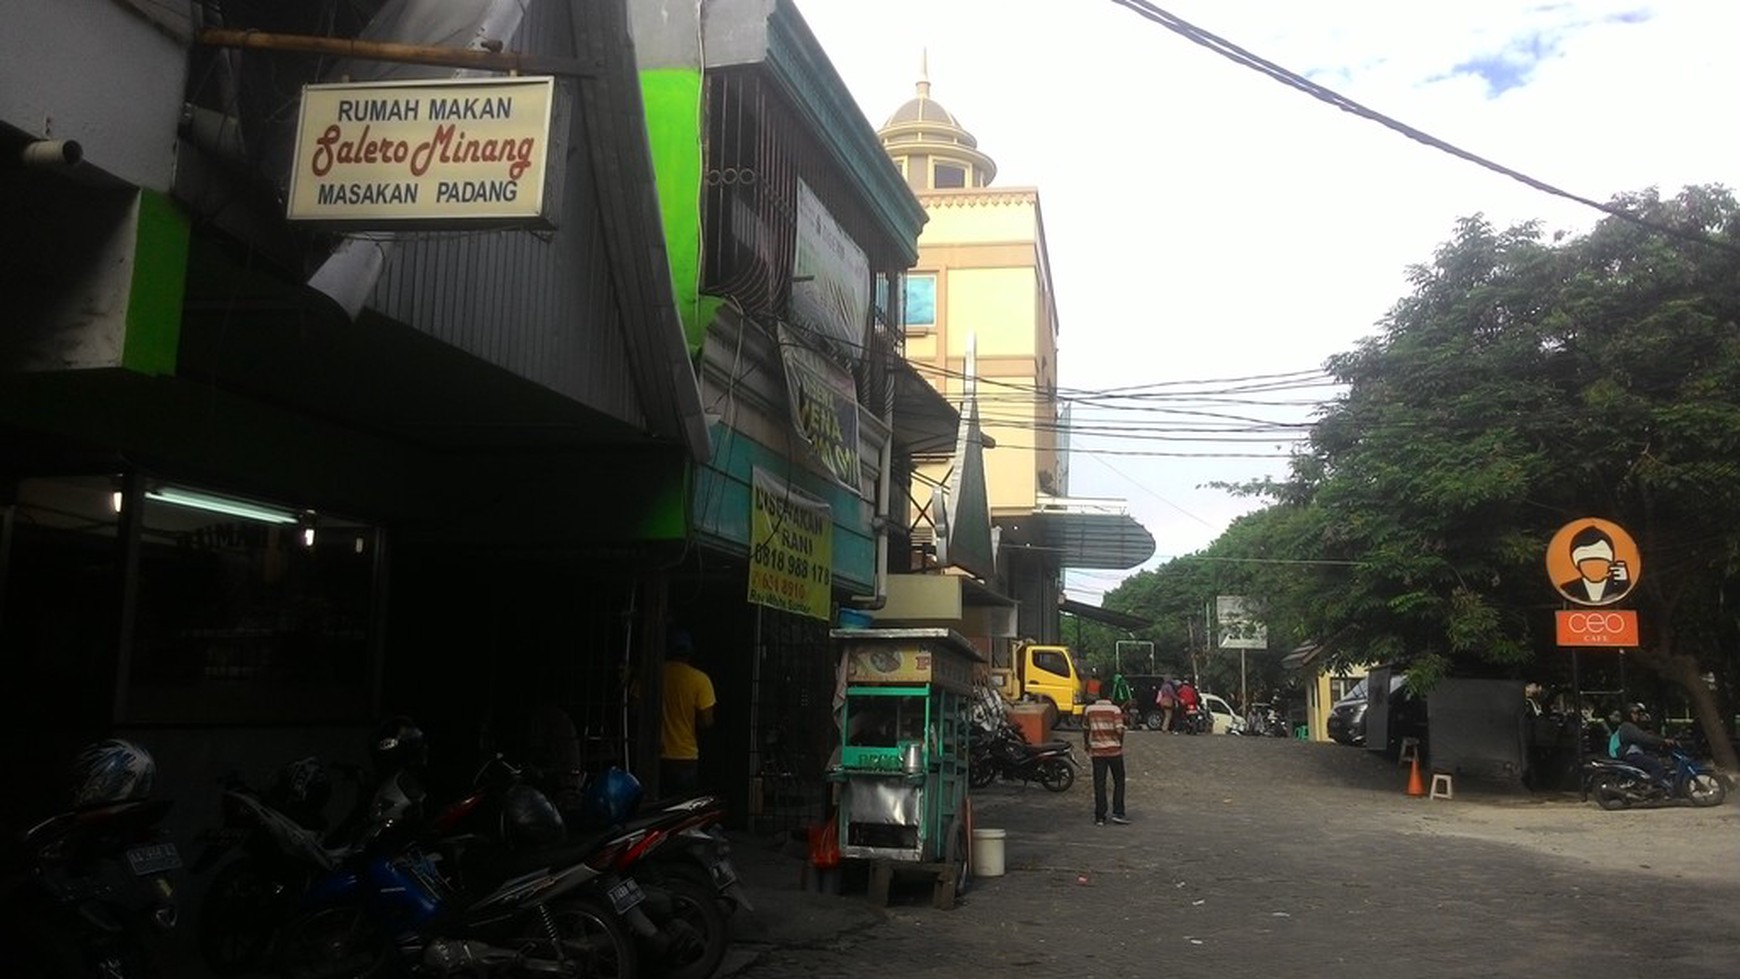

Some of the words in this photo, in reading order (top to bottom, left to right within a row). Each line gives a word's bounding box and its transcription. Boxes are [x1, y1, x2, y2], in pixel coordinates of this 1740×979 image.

[338, 100, 419, 122] RUMAH
[428, 97, 512, 120] MAKAN
[311, 124, 409, 178] Salero
[410, 123, 535, 180] Minang
[317, 183, 418, 205] MASAKAN
[436, 180, 518, 203] PADANG
[1568, 613, 1625, 633] ceo
